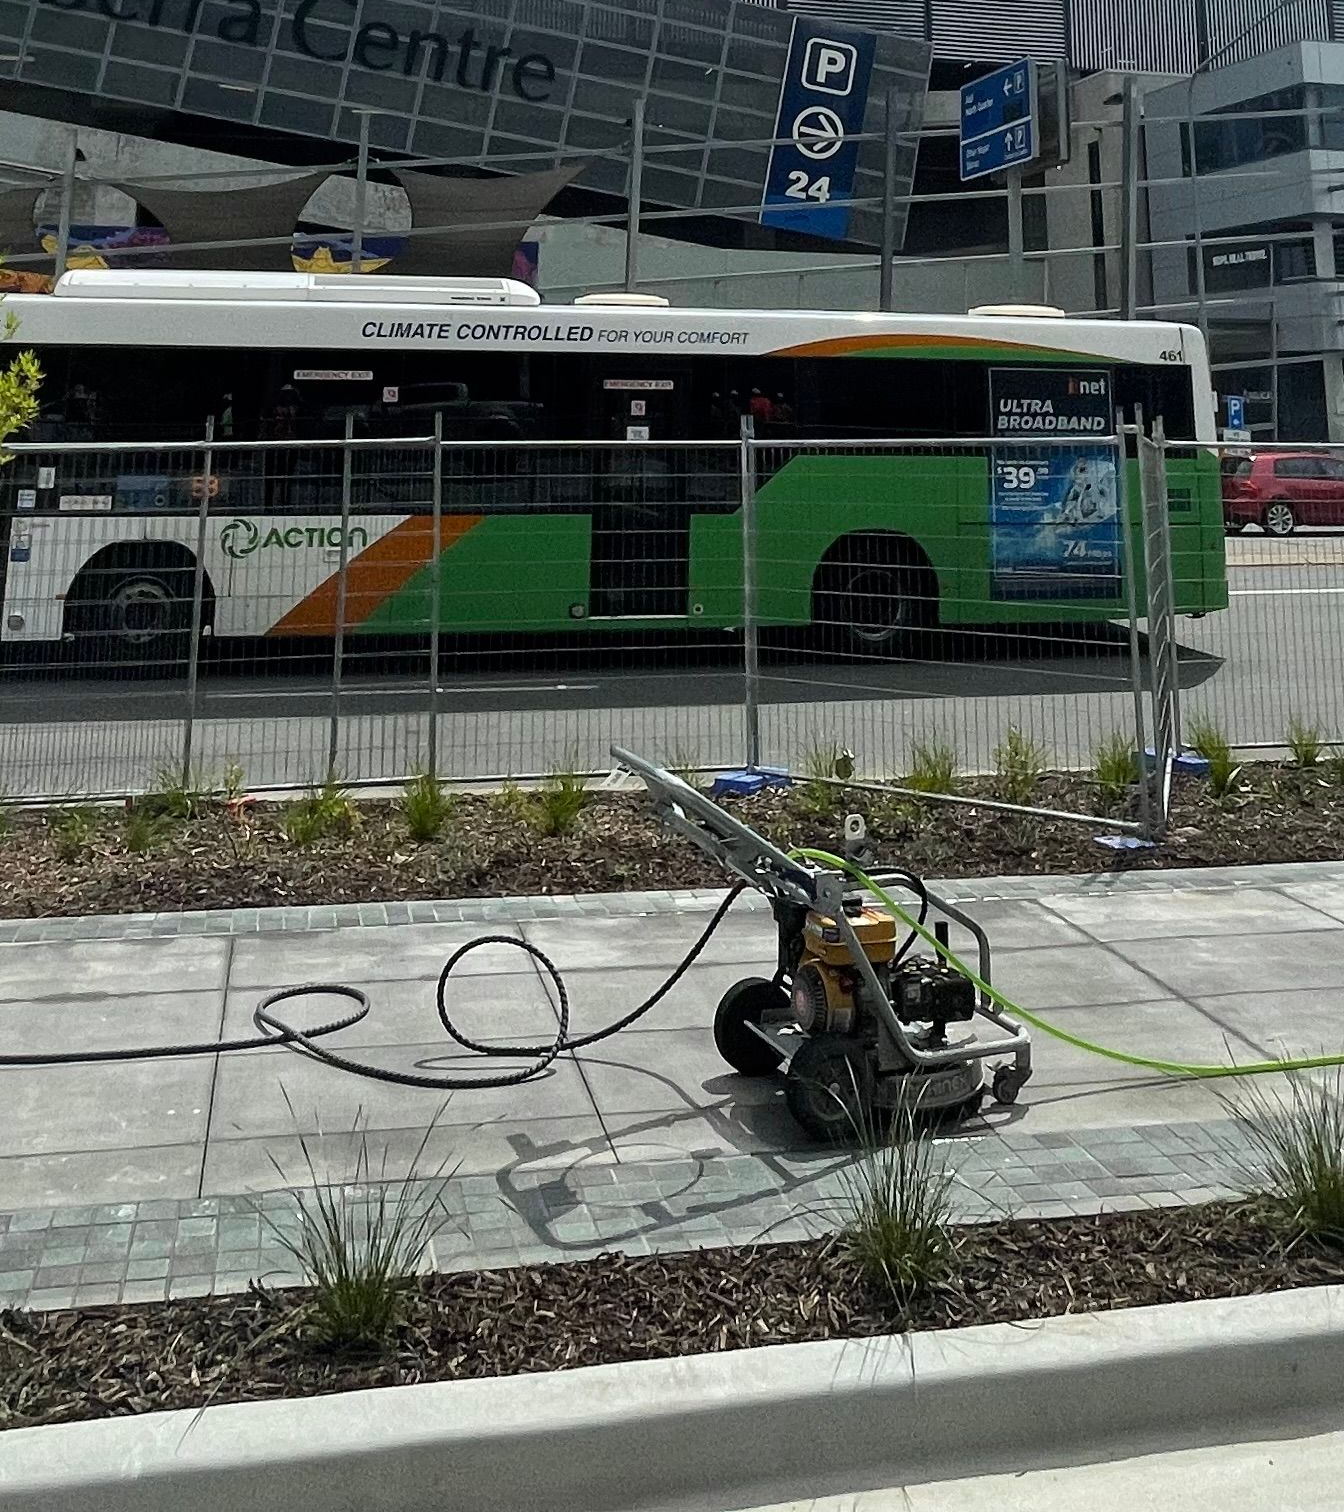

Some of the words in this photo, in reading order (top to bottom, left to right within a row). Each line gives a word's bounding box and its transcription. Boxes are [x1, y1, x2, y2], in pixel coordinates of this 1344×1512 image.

[816, 48, 846, 83] P
[785, 171, 830, 203] 24
[361, 321, 451, 339] CLIMATE
[456, 324, 594, 342] CONTROLLED
[597, 330, 629, 343] FOR
[633, 331, 674, 344] YOUR
[677, 331, 750, 345] COMFORT
[1159, 350, 1183, 362] 461
[1000, 399, 1054, 413] ULTRA
[1231, 400, 1240, 415] P
[997, 416, 1106, 430] BROADBAND
